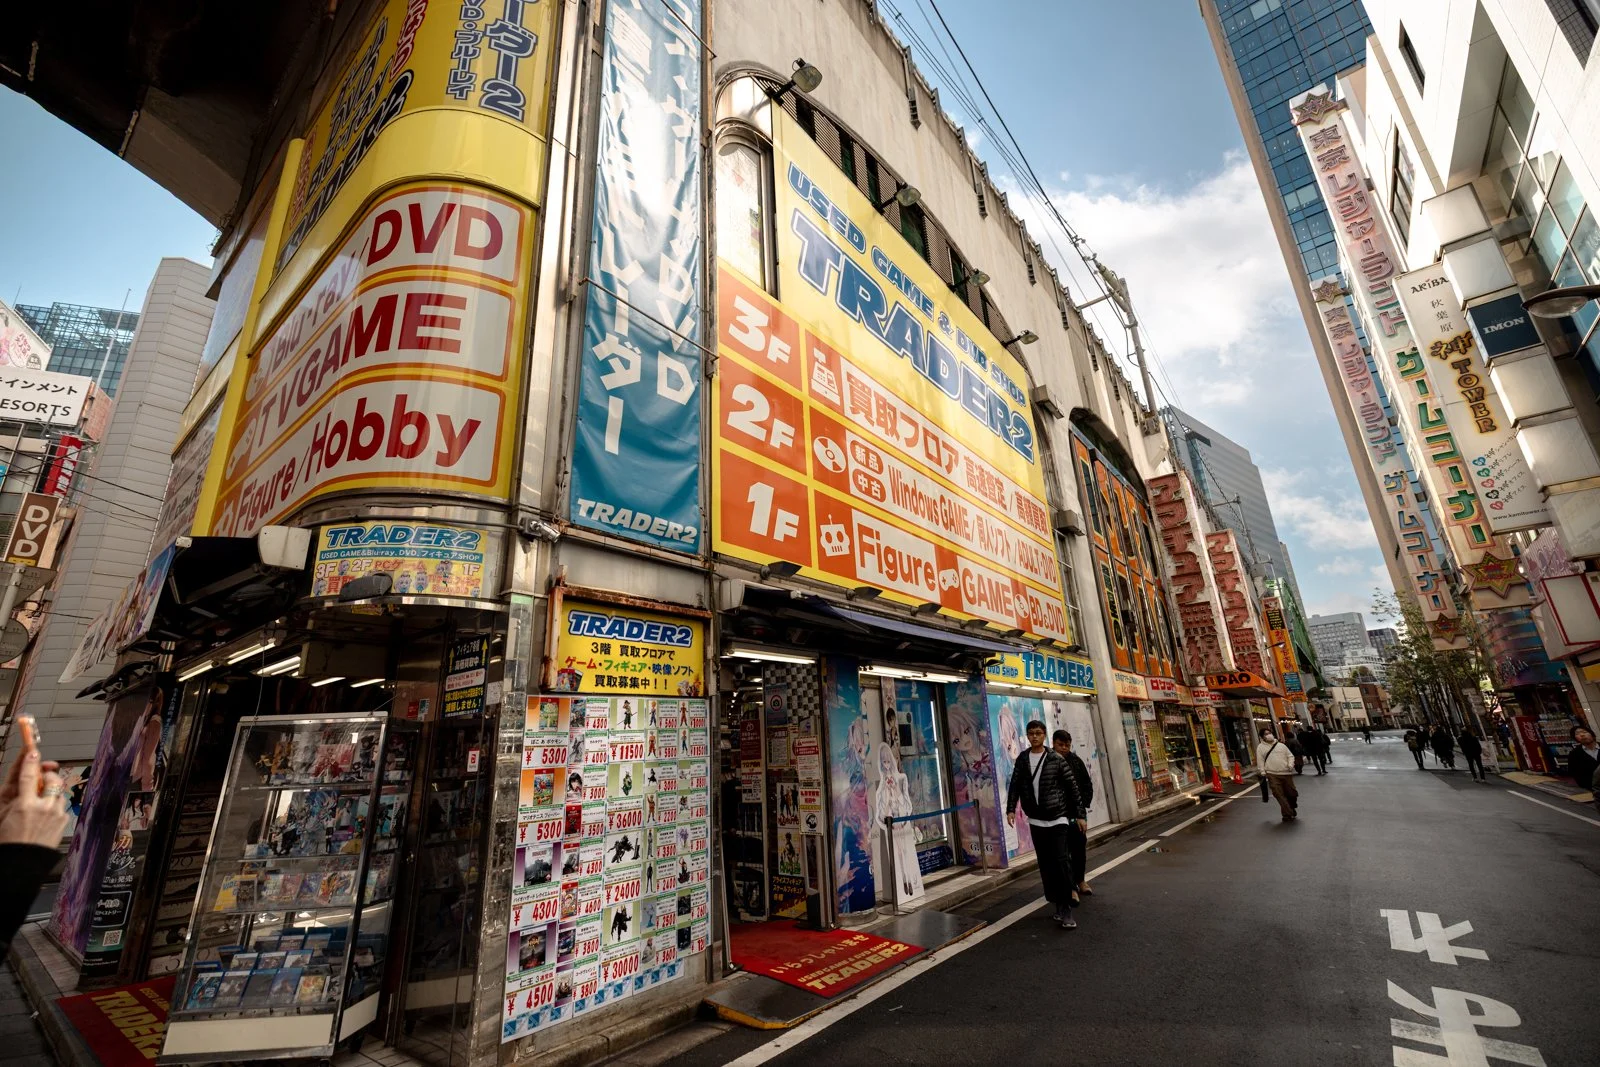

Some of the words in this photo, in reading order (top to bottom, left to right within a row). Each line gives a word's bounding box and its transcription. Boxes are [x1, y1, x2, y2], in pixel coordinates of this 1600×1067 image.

[480, 0, 538, 122] ーダー2
[327, 48, 380, 152] DVD
[303, 54, 394, 207] Blu-ray
[788, 160, 866, 254] USED
[870, 245, 935, 320] GAME
[938, 311, 955, 340] &
[955, 325, 989, 373] DVD
[990, 365, 1027, 408] SHOP
[1431, 298, 1454, 333] 秋葉原
[1483, 316, 1526, 335] IMON
[727, 294, 792, 364] 3F
[790, 207, 1034, 466] TRADER2
[0, 377, 78, 396] インメント
[1451, 357, 1498, 434] TOWER
[726, 383, 796, 449] 2F
[846, 370, 959, 476] 買取フロア
[854, 445, 880, 471] 新品
[1396, 346, 1490, 545] ゲームコーナー
[857, 475, 882, 499] 中古
[577, 497, 698, 544] TRADER2
[747, 481, 800, 543] 1F
[12, 504, 50, 558] DVD
[326, 524, 482, 550] TRADER2
[1383, 470, 1442, 609] ゲームコーナー
[321, 551, 338, 560] USED
[351, 558, 374, 573] 2F
[856, 523, 937, 592] Figure
[316, 562, 337, 579] 3F
[462, 563, 481, 576] 1F
[961, 567, 1015, 618] GAME
[568, 609, 693, 648] TRADER2
[591, 642, 611, 656] 3階
[619, 644, 676, 661] 買取フロアで
[1021, 651, 1095, 690] TRADER2
[1215, 673, 1251, 686] PAO
[592, 718, 608, 730] 4300
[525, 751, 532, 765] ¥
[541, 747, 567, 765] 5300
[591, 751, 607, 765] 4000
[611, 748, 617, 760] ¥
[619, 743, 644, 760] 11500
[590, 787, 606, 799] 3000
[520, 828, 526, 842] ¥
[536, 820, 562, 841] 5300
[587, 823, 604, 837] 3500
[608, 816, 614, 830] ¥
[616, 810, 642, 829] 36000
[586, 860, 603, 875] 4300
[605, 888, 611, 903] ¥
[614, 879, 641, 903] 24000
[514, 912, 520, 926] ¥
[532, 898, 557, 922] 4300
[582, 938, 599, 956] 3800
[603, 966, 609, 983] ¥
[612, 953, 639, 979] 30000
[806, 943, 910, 990] TRADER2
[519, 976, 534, 988] 仁王
[535, 975, 540, 983] 3
[580, 979, 598, 998] 3800
[507, 999, 515, 1015] ¥
[525, 981, 554, 1010] 4500
